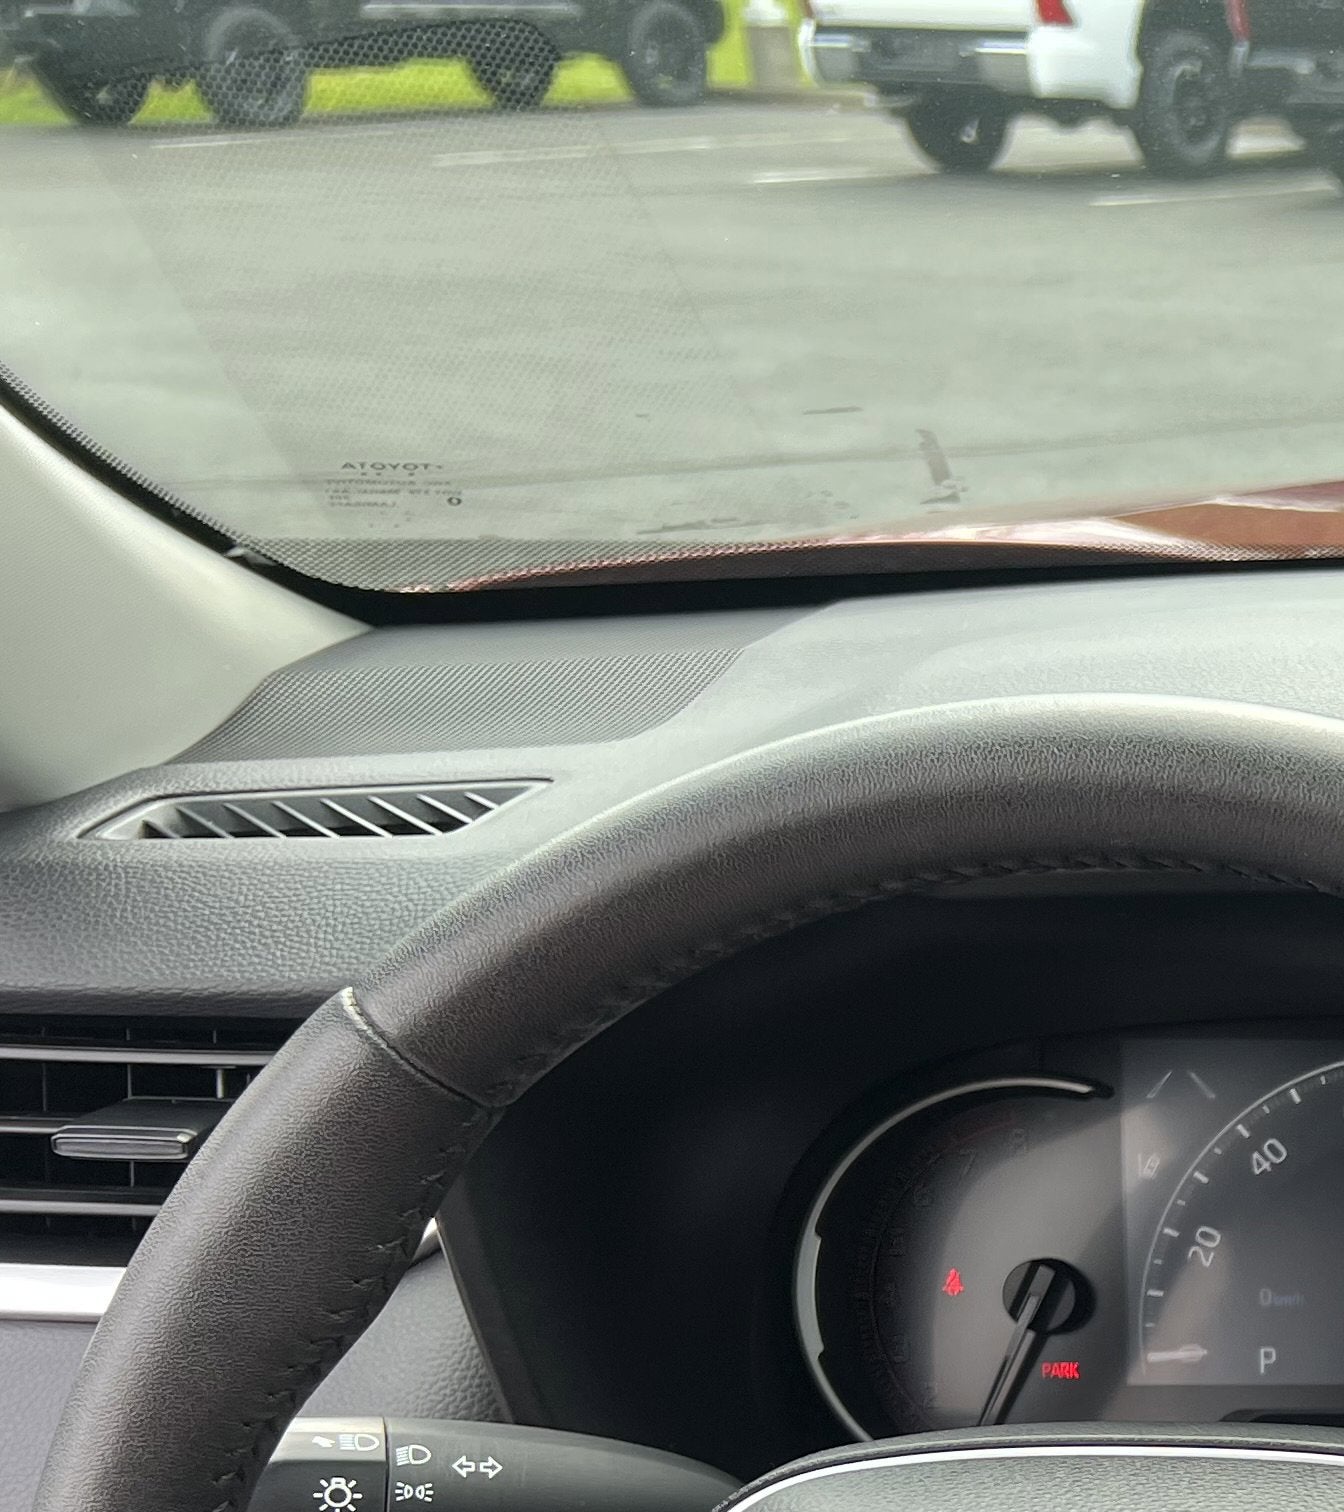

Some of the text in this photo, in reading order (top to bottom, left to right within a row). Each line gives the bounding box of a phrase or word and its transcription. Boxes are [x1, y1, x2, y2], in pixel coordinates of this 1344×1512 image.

[1252, 1139, 1287, 1174] 40
[1187, 1226, 1222, 1268] 20
[1042, 1362, 1080, 1380] PARK
[1260, 1347, 1276, 1374] P
